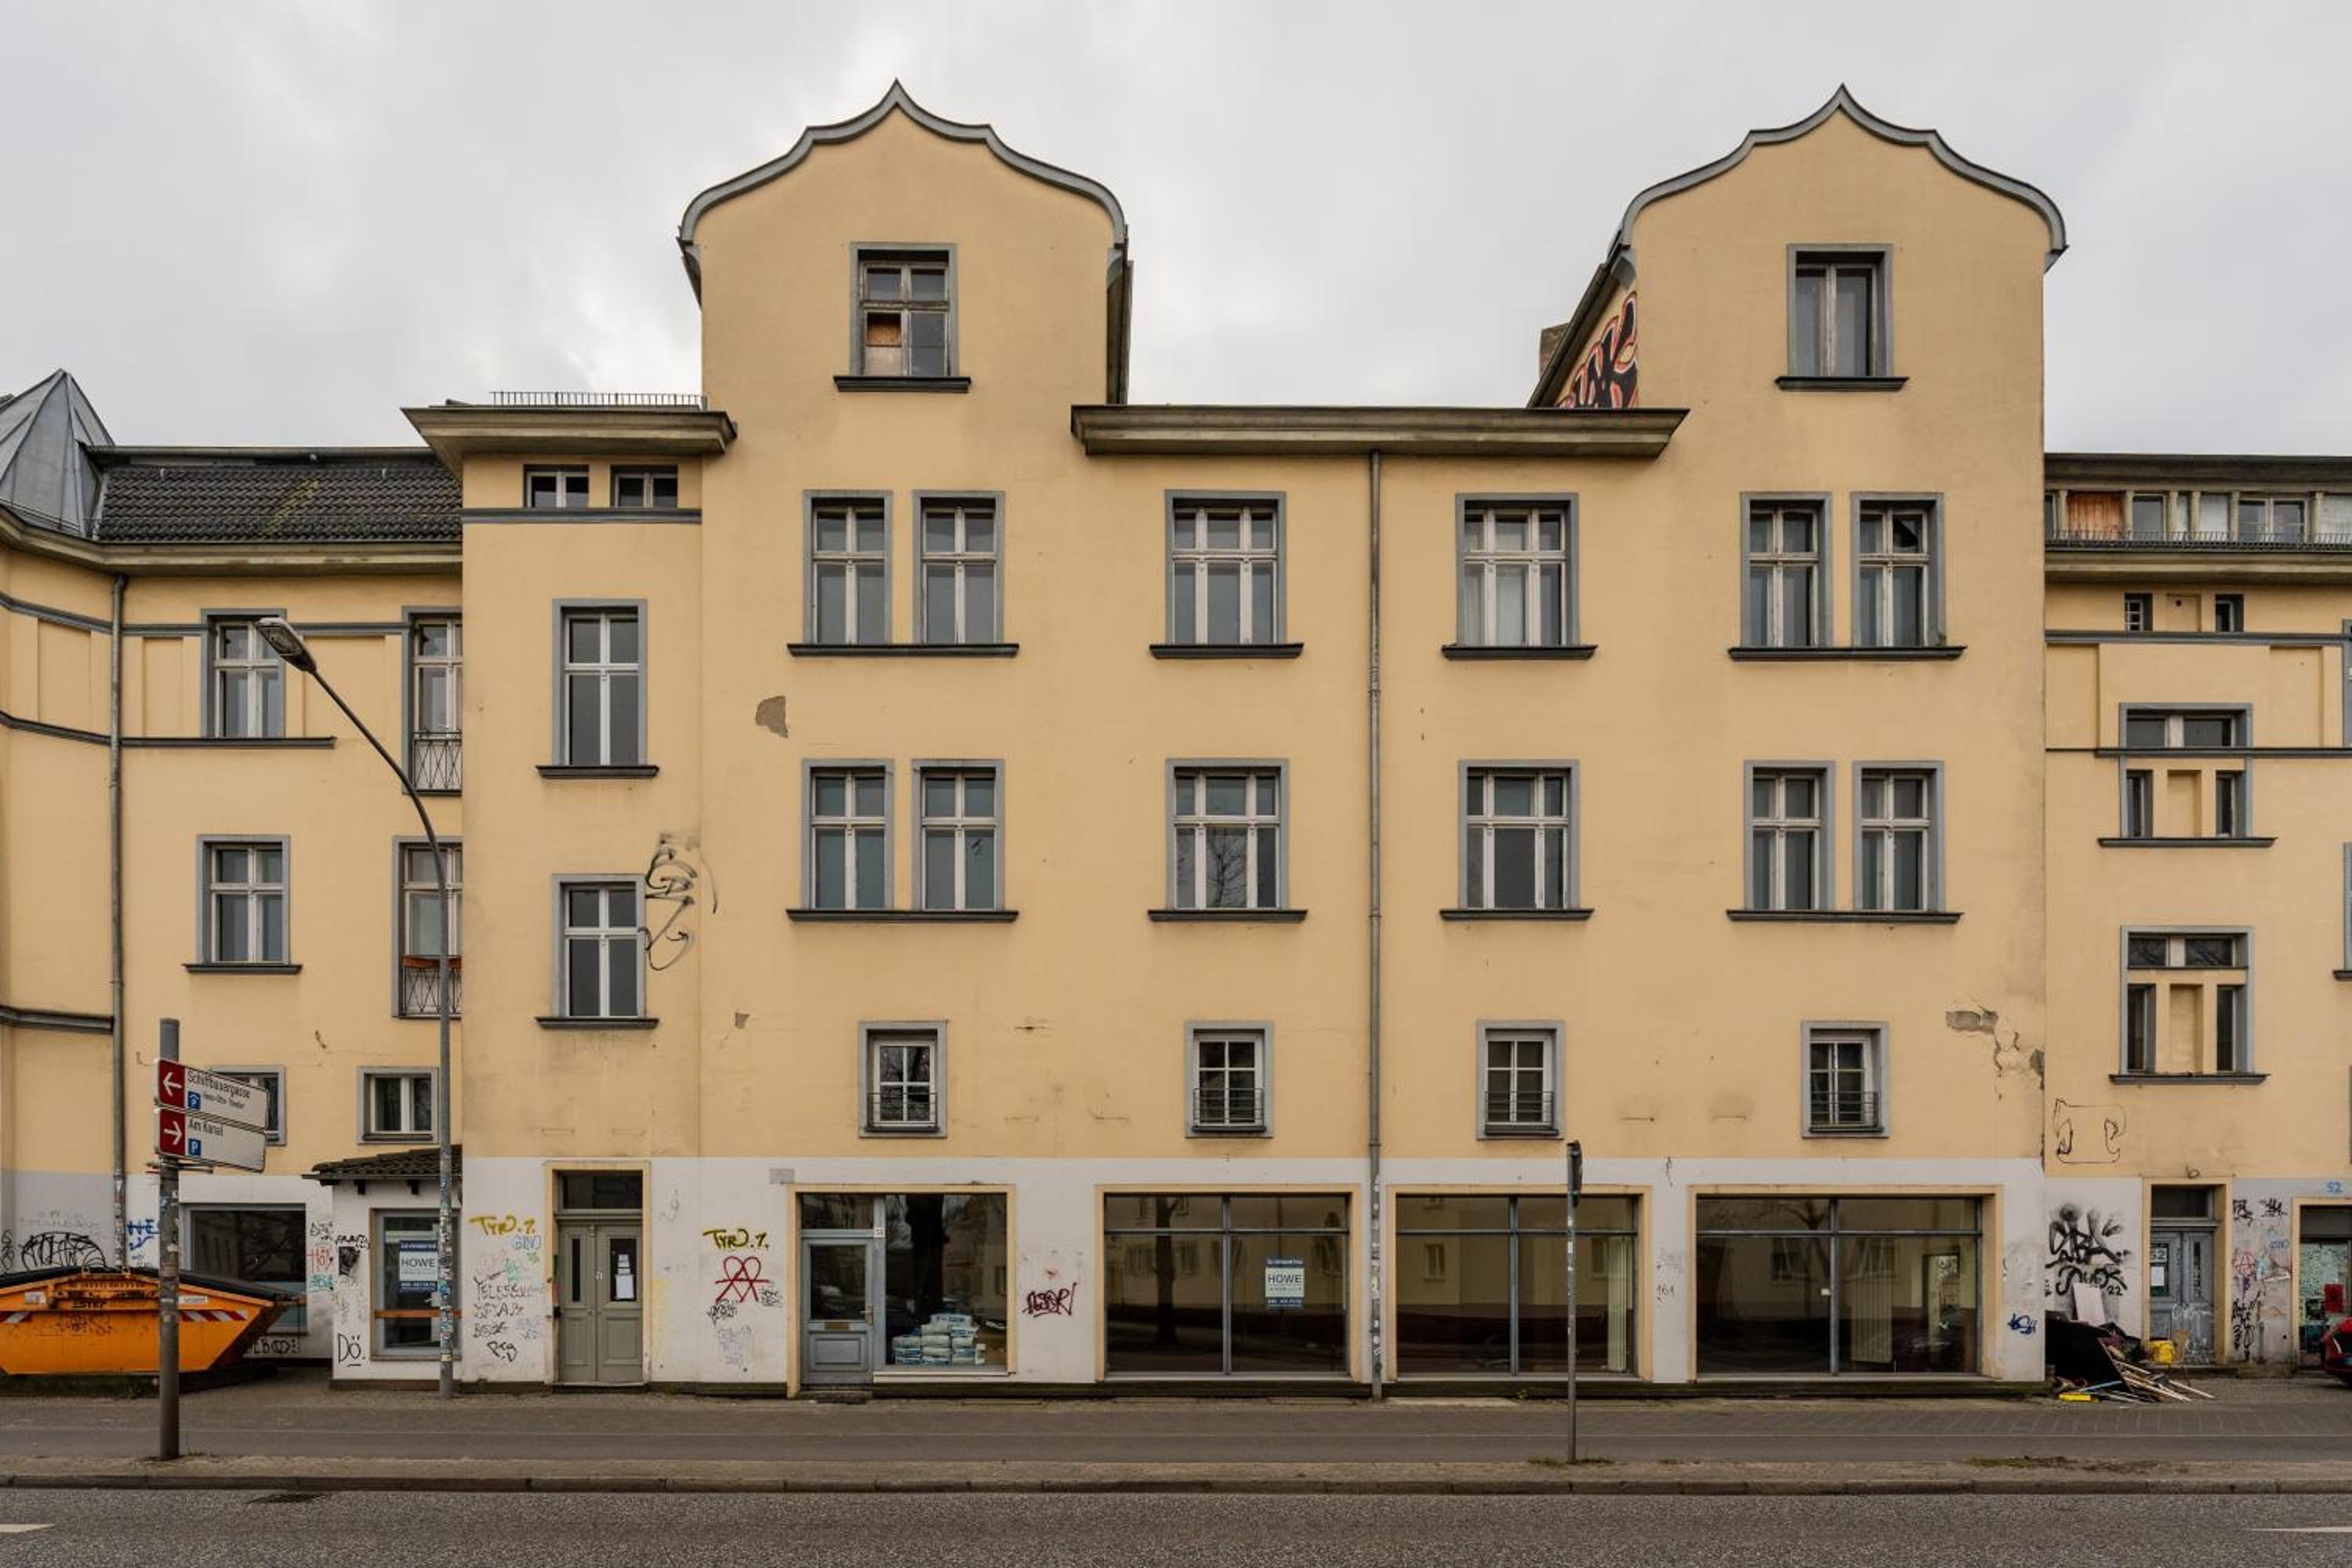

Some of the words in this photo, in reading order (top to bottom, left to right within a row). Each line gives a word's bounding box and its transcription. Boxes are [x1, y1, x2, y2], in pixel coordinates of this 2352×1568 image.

[188, 1116, 201, 1131] Am
[202, 1120, 223, 1136] Kanal
[401, 1258, 436, 1268] HOWE
[1268, 1274, 1302, 1283] HOWE
